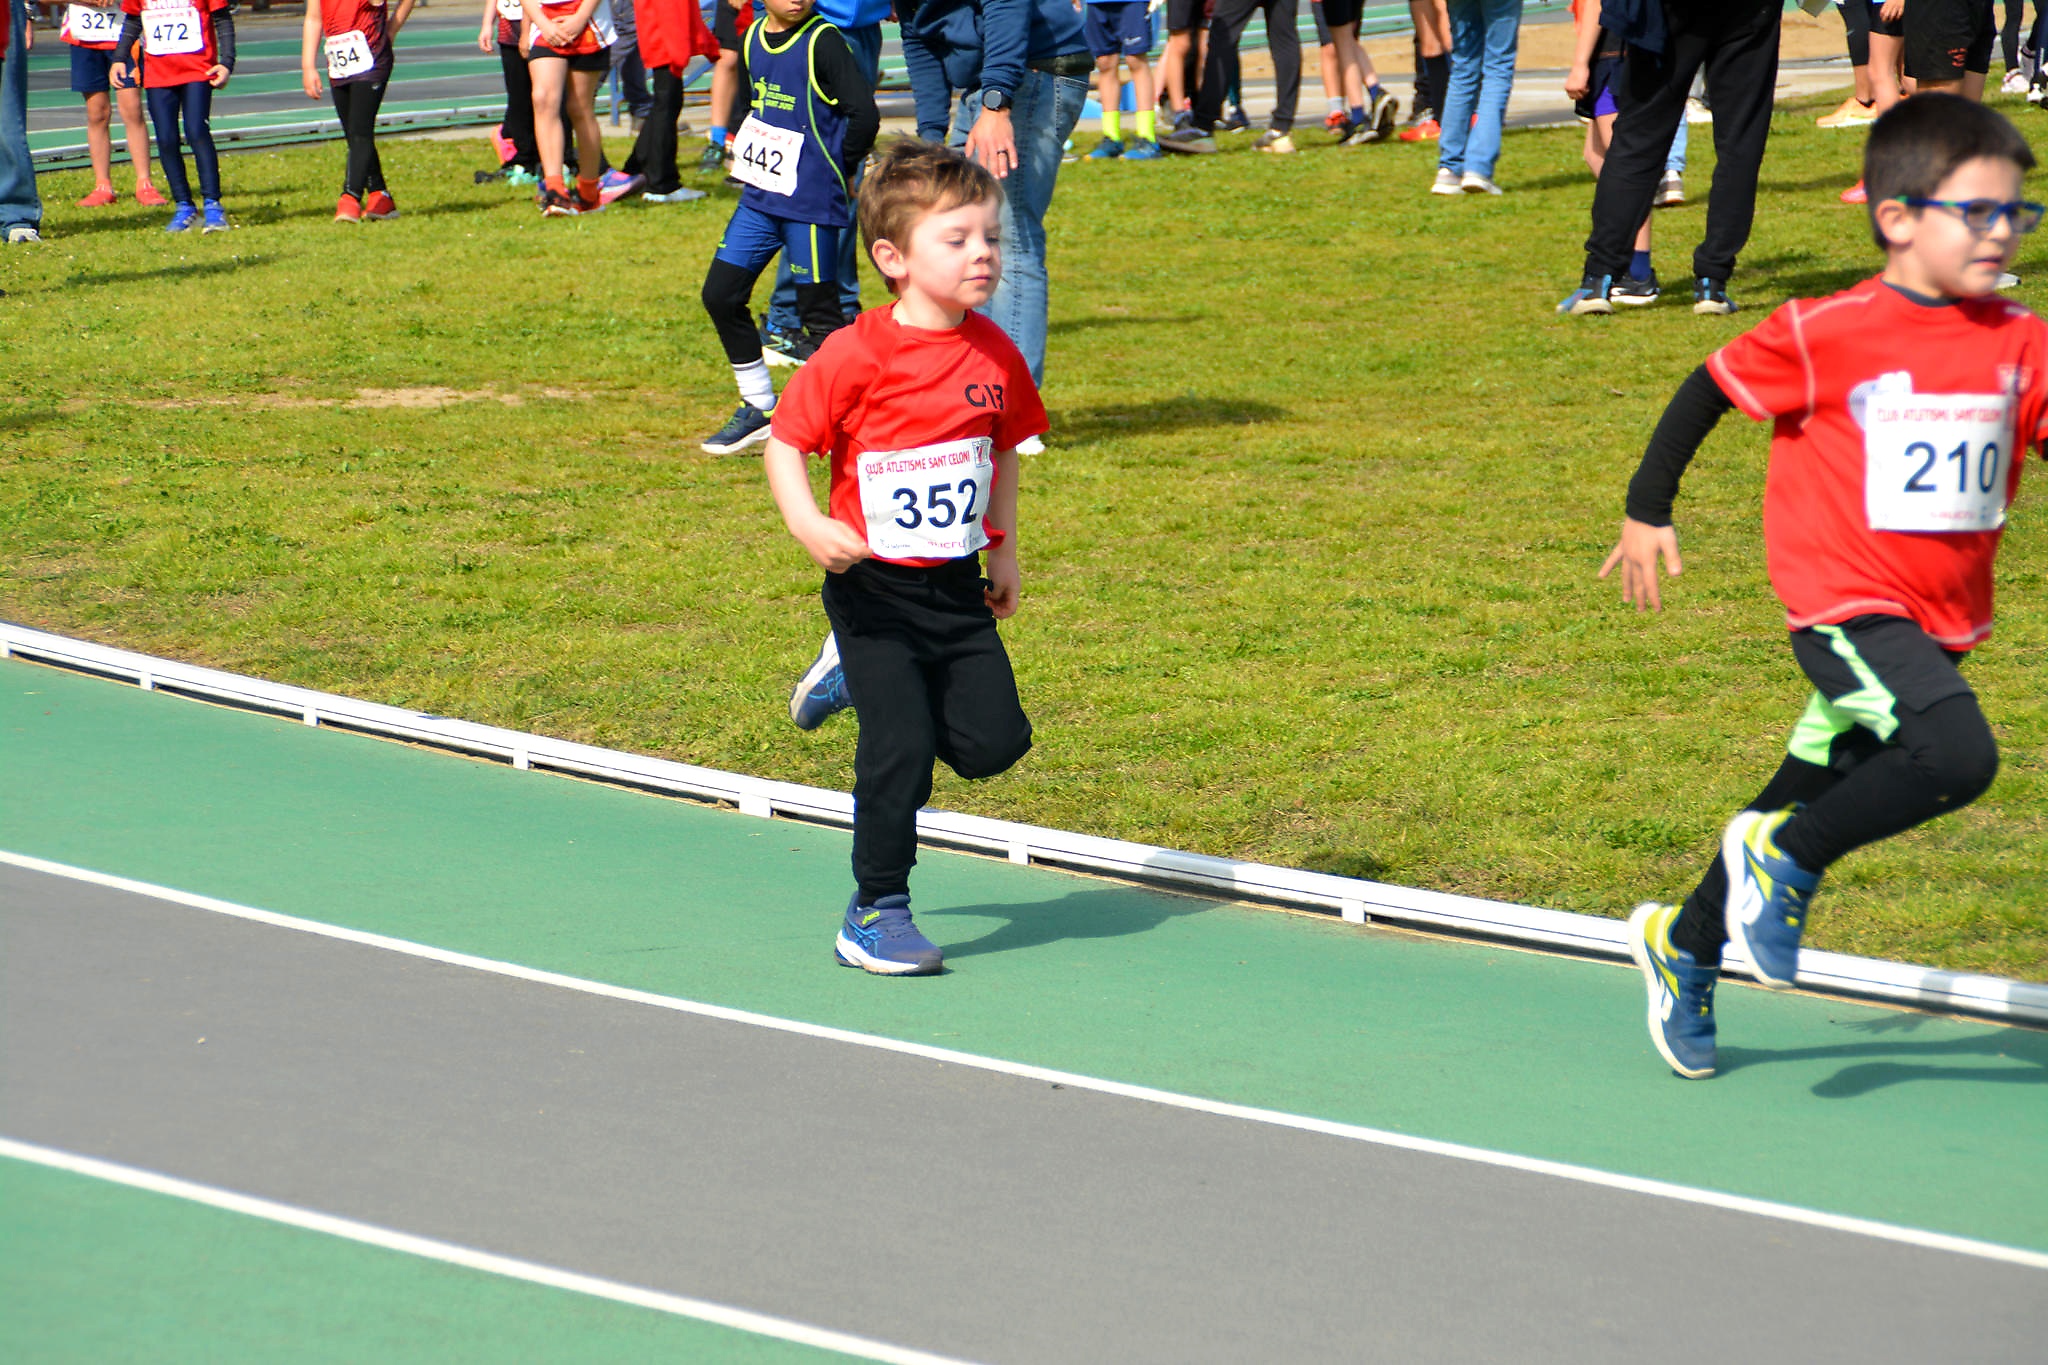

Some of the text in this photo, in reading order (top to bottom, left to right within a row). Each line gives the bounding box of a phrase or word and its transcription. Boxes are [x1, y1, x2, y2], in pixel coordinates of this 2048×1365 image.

[81, 13, 116, 30] 327
[153, 23, 189, 42] 472
[743, 142, 784, 176] 442
[865, 450, 970, 475] CLUB ATLETISME SANT CELONI
[1903, 440, 1998, 493] 210
[892, 478, 977, 530] 352
